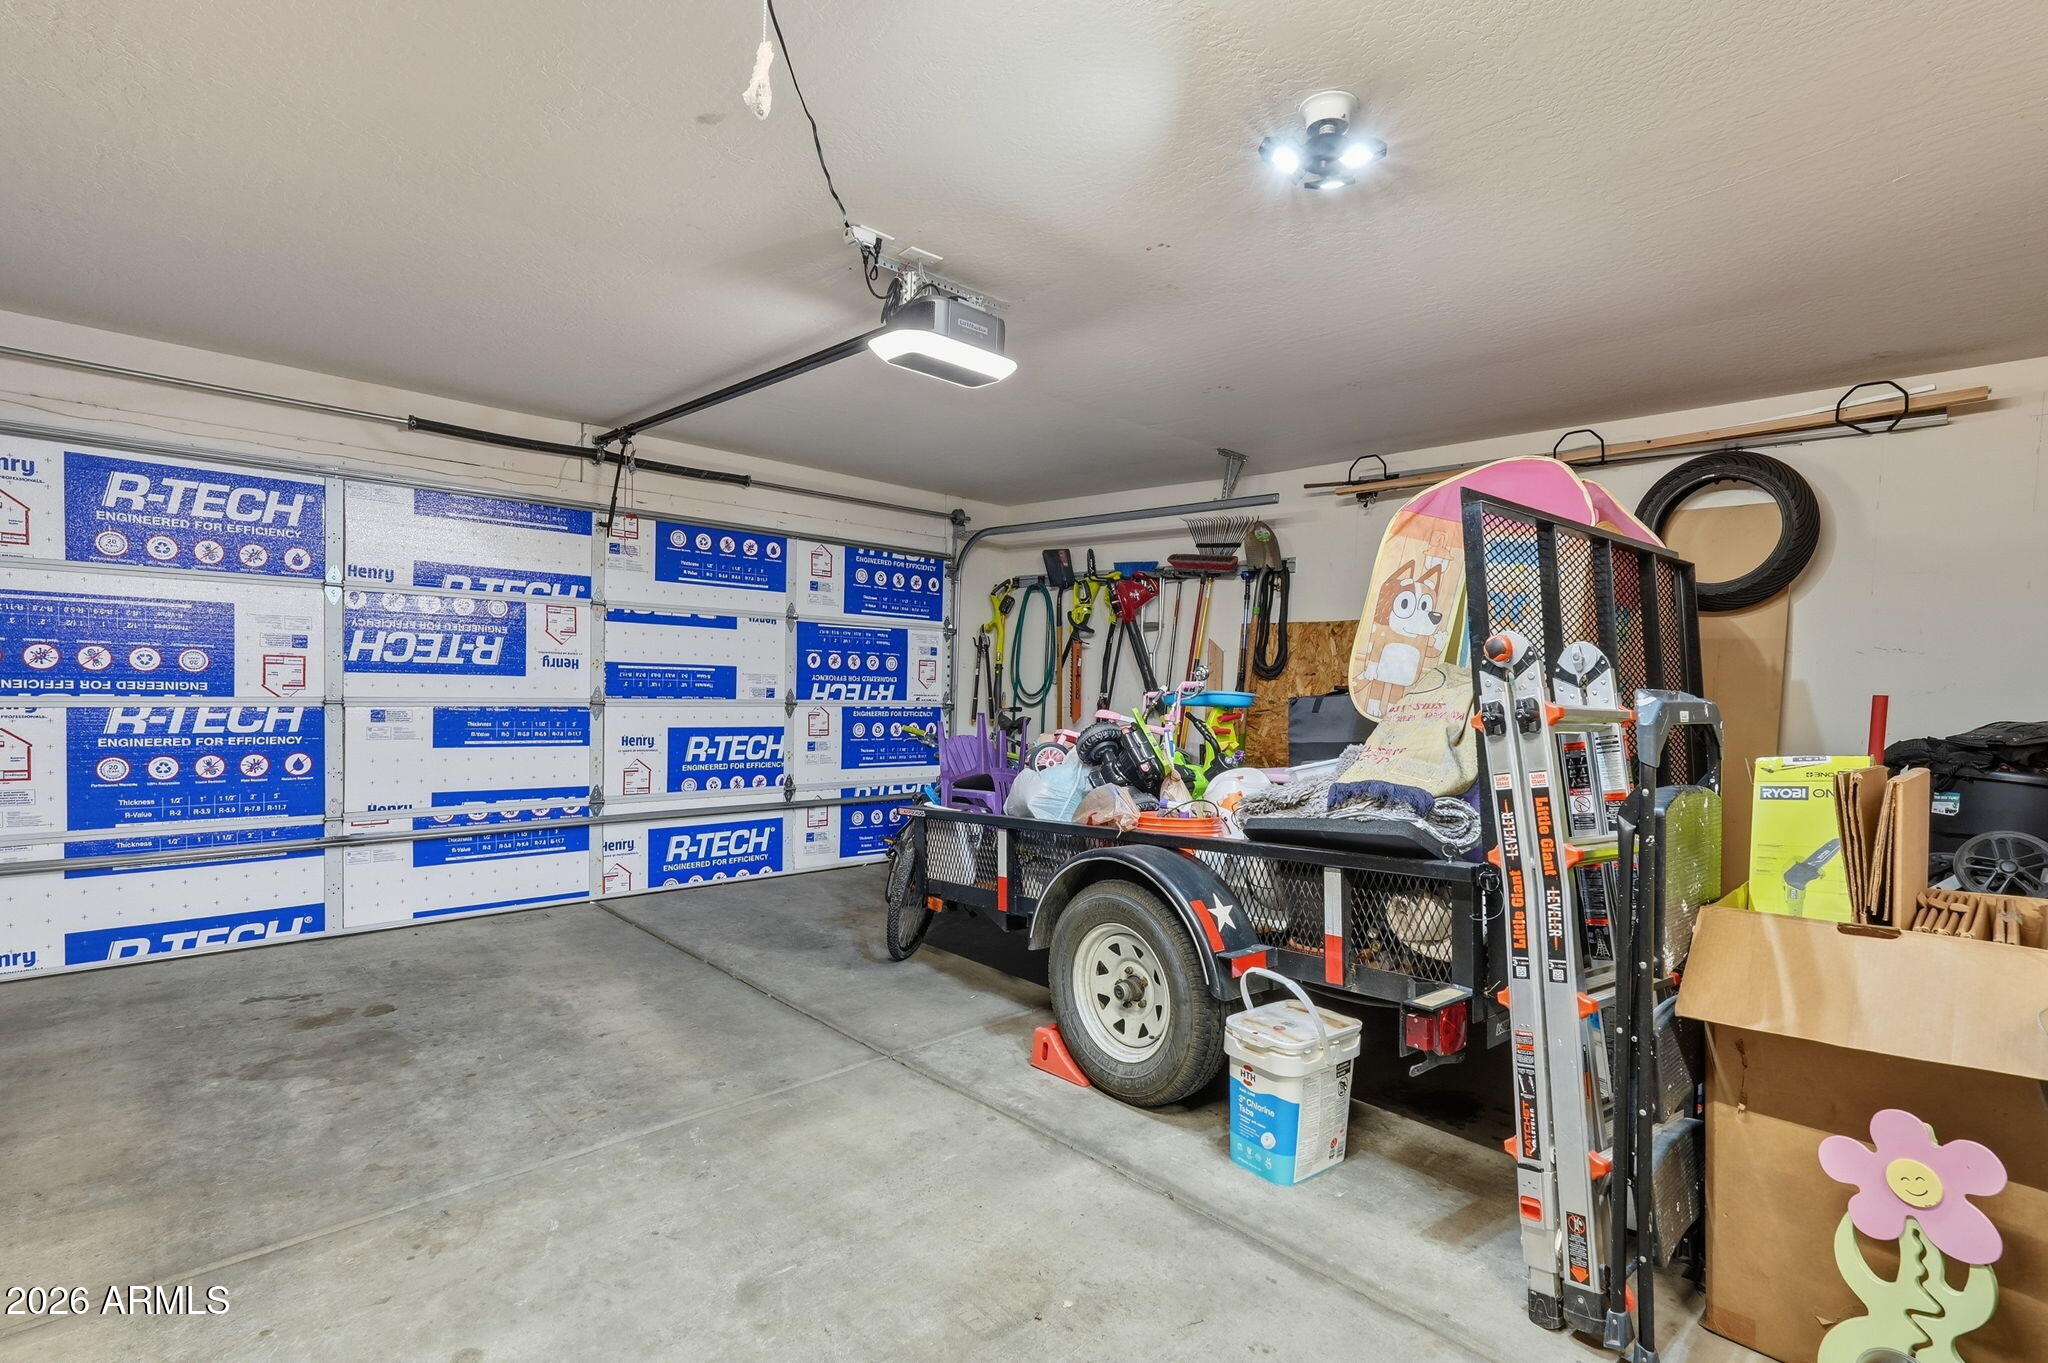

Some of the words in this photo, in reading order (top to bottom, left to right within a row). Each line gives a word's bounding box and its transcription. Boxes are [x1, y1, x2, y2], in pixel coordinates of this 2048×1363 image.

[95, 510, 190, 530] ENGINEERED
[195, 520, 222, 533] FOR
[227, 522, 302, 539] EFFICIENCY
[347, 563, 394, 583] Henry
[348, 630, 506, 665] R-TECH
[542, 654, 579, 670] Henry
[80, 679, 111, 690] FOR
[116, 679, 208, 691] ENGINEERED
[103, 707, 304, 735] R-TECH
[97, 737, 191, 748] ENGINEERED
[195, 736, 224, 746] FOR
[227, 735, 303, 746] EFFICIENCY
[621, 735, 654, 749] Henry
[684, 734, 785, 763] R-TECH
[681, 763, 729, 772] ENGINEERED
[1762, 788, 1807, 799] RYOBI
[1534, 797, 1552, 836] Little
[1501, 811, 1519, 857] LEVELER
[117, 840, 152, 849] Thickness
[663, 860, 711, 872] ENGINEERED
[728, 854, 769, 865] EFFICIENCY
[1540, 838, 1557, 876] Giant
[1508, 870, 1525, 907] Giant
[1546, 889, 1563, 937] LEVELER
[1512, 911, 1527, 949] Little
[1240, 1069, 1256, 1082] HTH
[1238, 1103, 1255, 1117] Tabs
[1246, 1098, 1275, 1118] Chlorine
